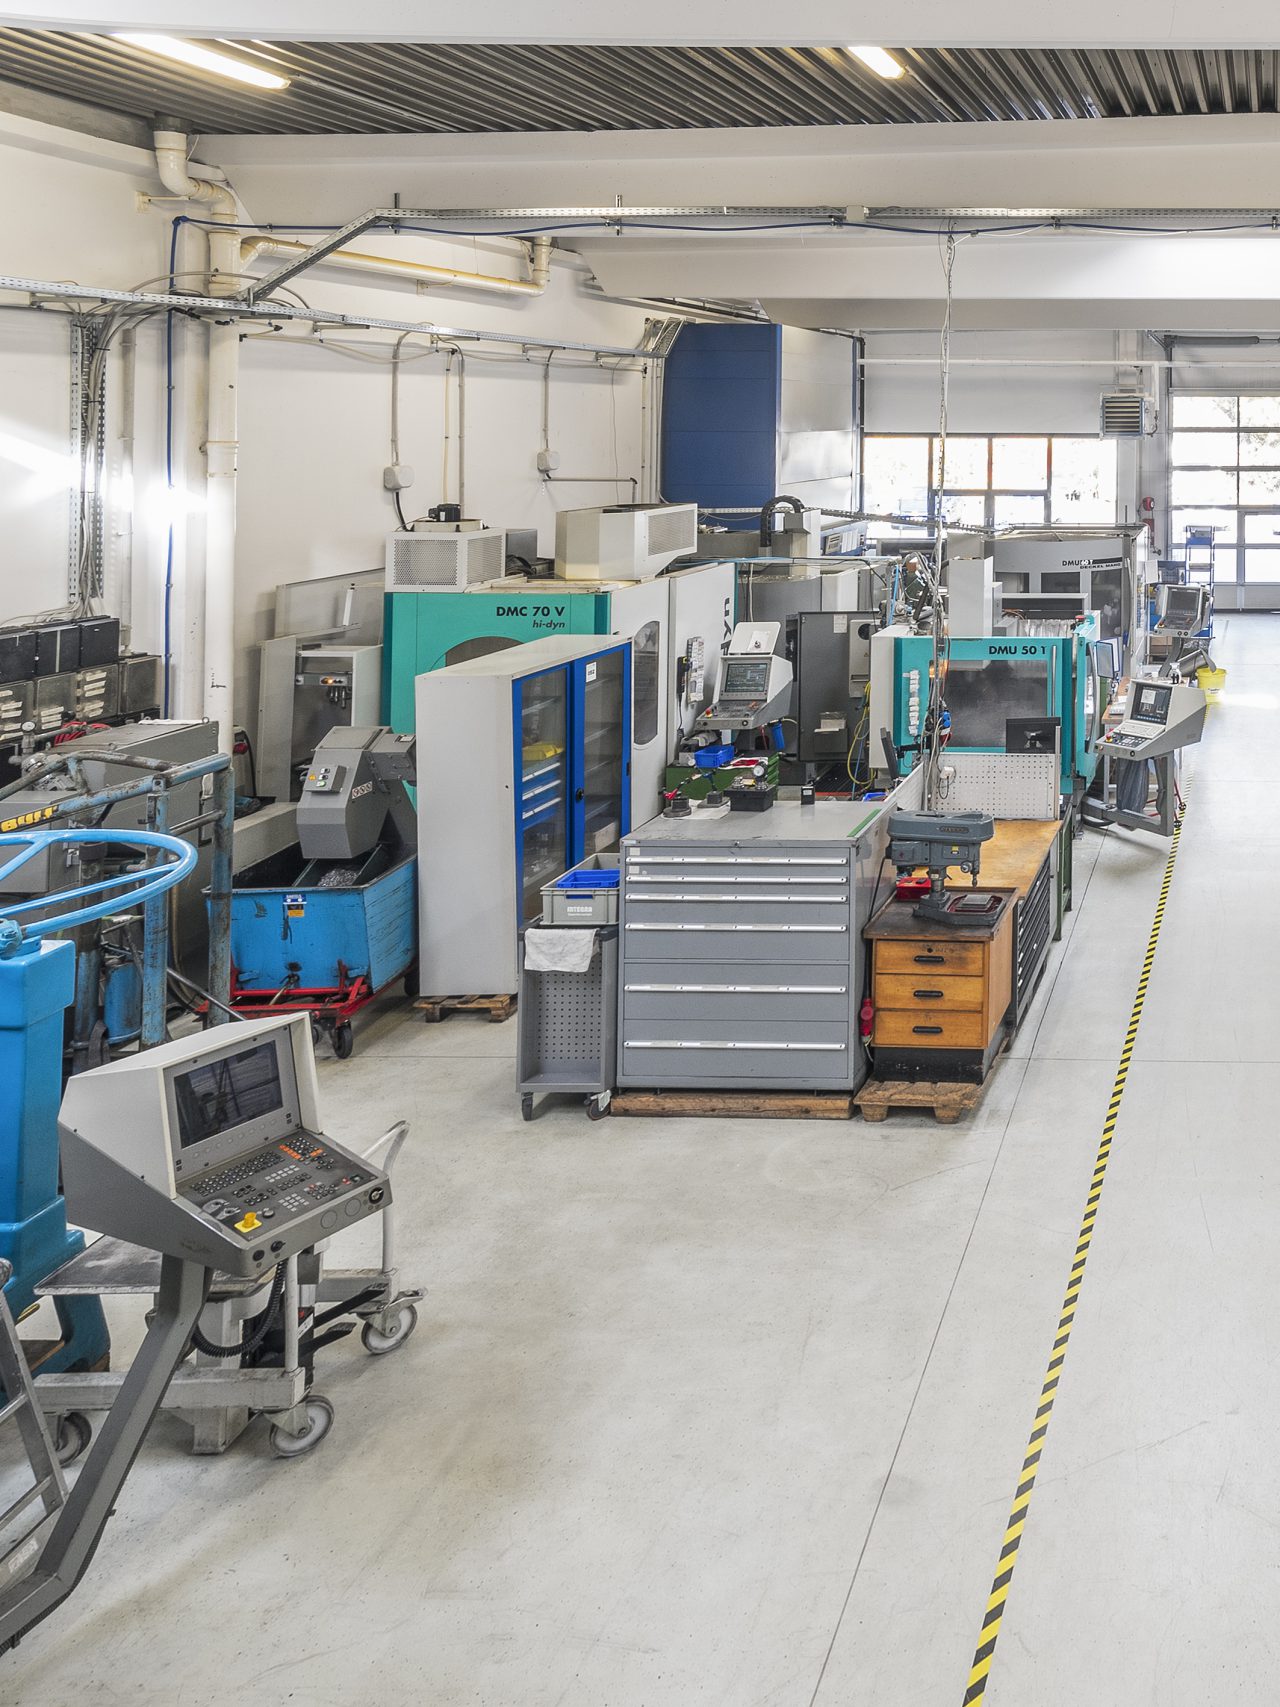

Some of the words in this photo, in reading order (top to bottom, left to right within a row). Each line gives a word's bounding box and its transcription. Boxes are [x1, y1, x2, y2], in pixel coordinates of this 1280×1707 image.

[496, 606, 528, 617] DMC
[532, 606, 550, 617] 70
[554, 606, 566, 617] V
[532, 619, 566, 631] hi-dyn
[989, 645, 1017, 655] DMU
[1021, 645, 1037, 655] 50
